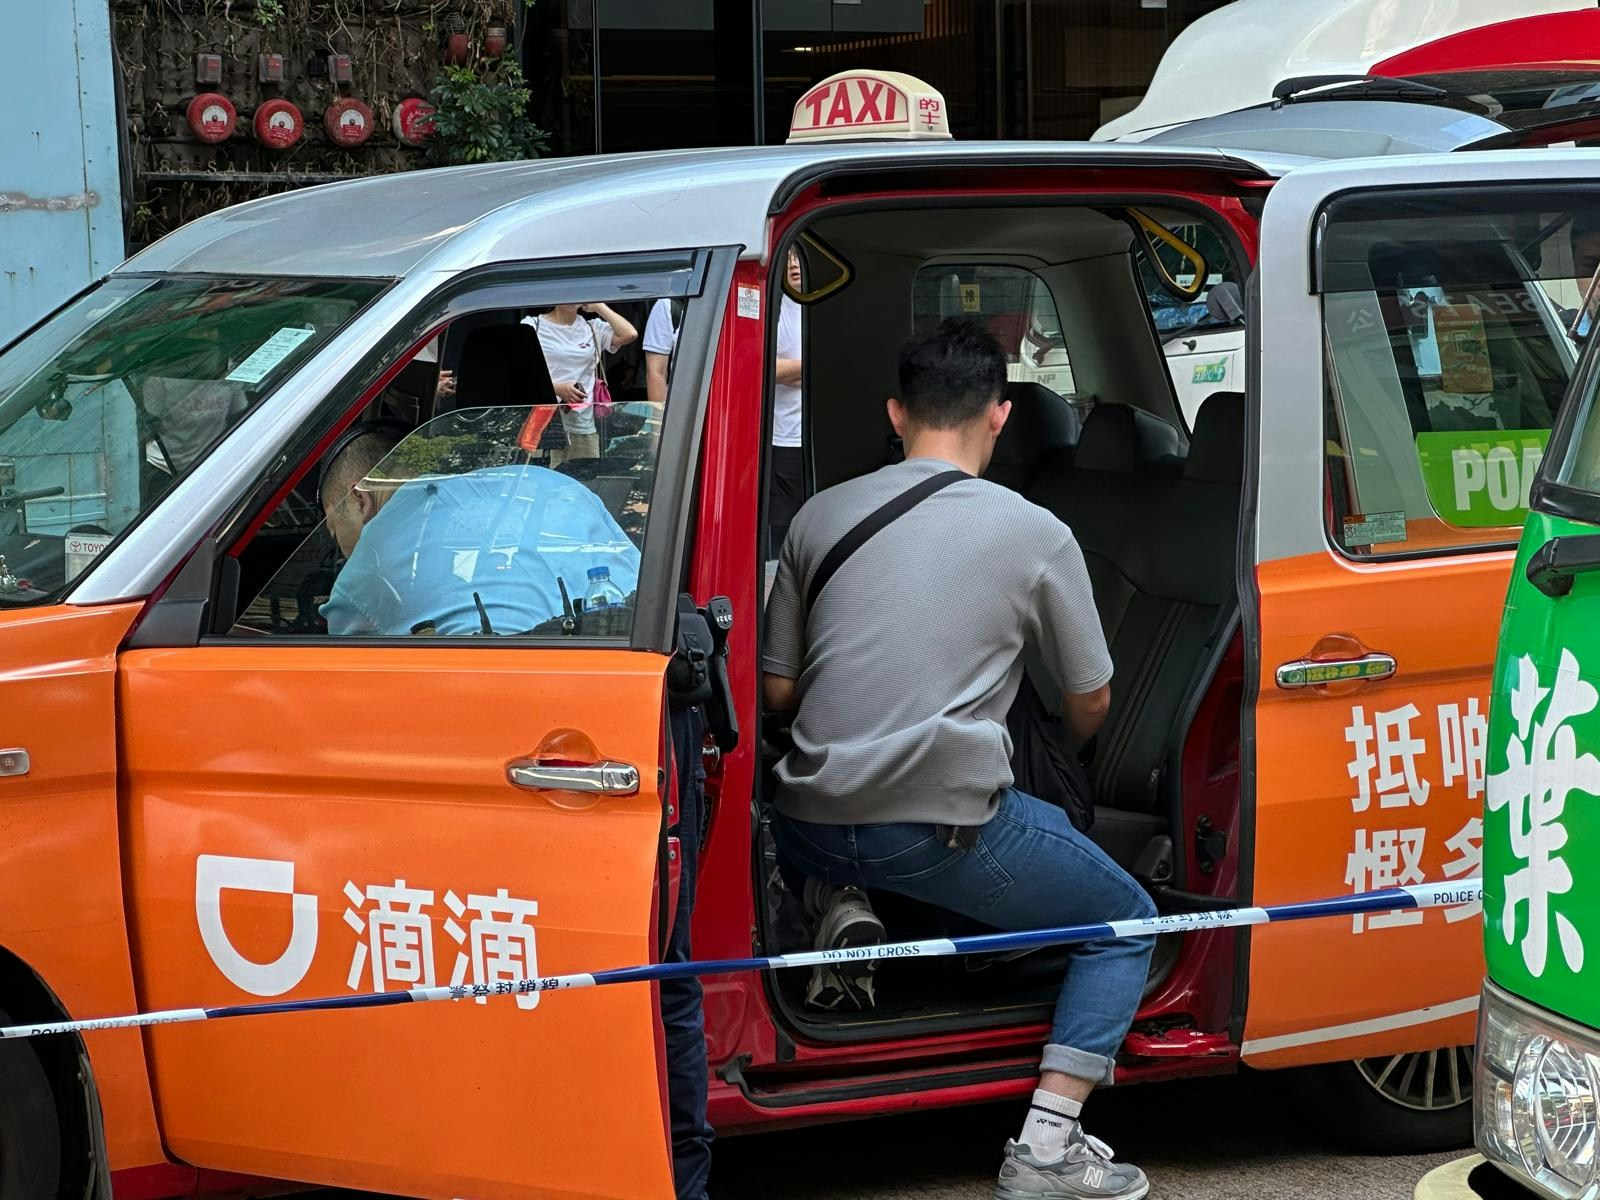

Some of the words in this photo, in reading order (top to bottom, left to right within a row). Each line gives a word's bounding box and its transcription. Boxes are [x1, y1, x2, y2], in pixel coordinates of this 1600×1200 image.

[805, 80, 897, 127] TAXI
[919, 97, 941, 127] 的士
[207, 160, 250, 174] SAI
[83, 543, 108, 553] TOYO
[1434, 890, 1474, 905] POLICE
[343, 879, 541, 1010] 滴滴
[846, 948, 873, 958] NOT
[878, 945, 920, 957] CROSS
[1082, 1166, 1103, 1189] N
